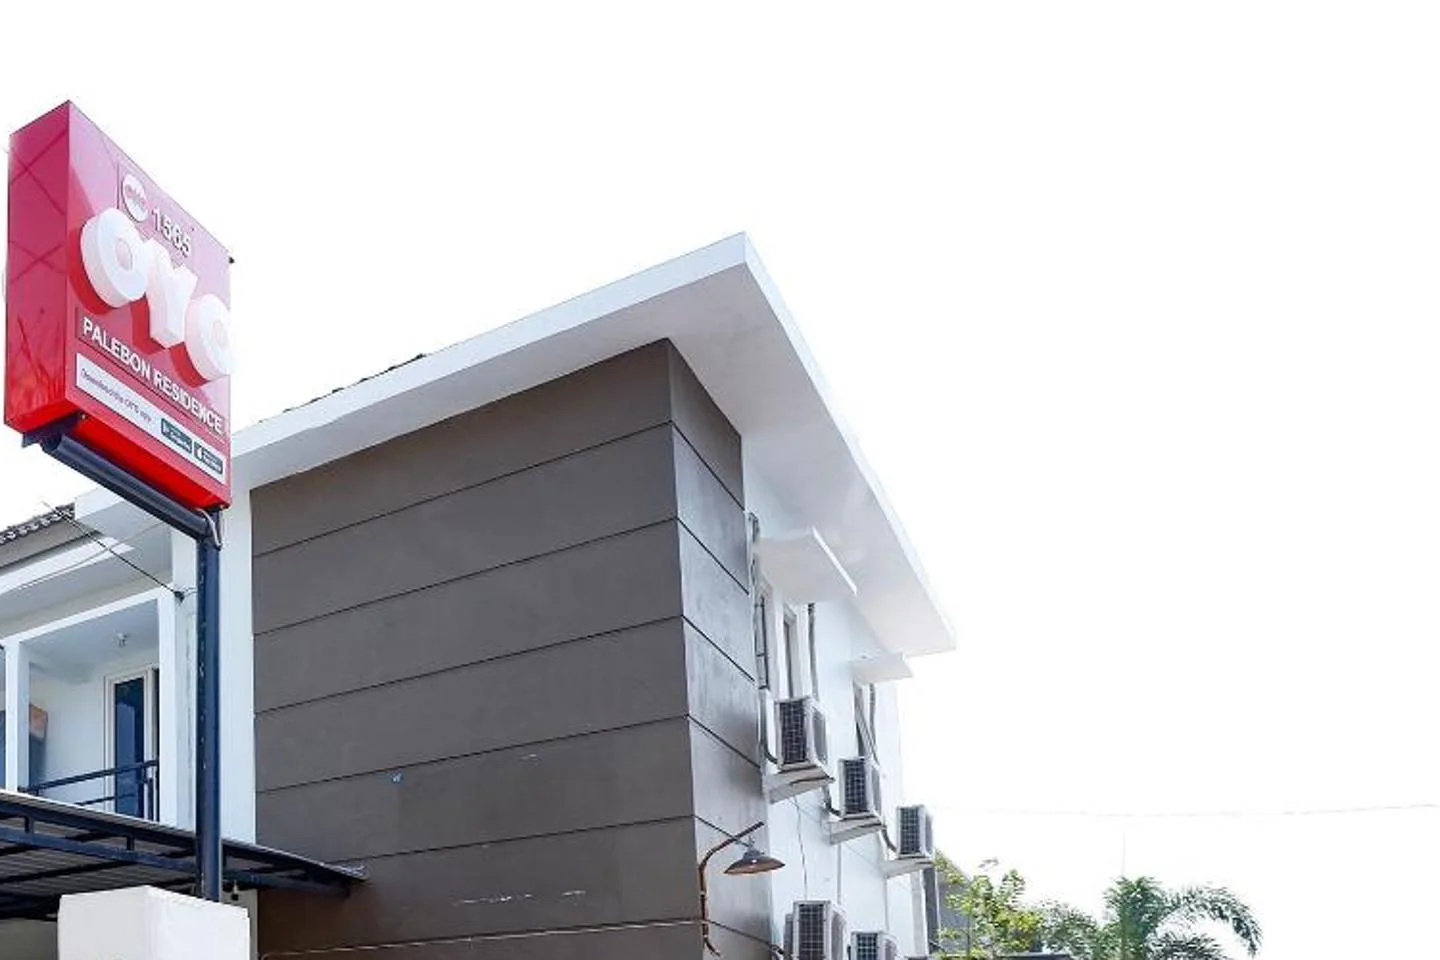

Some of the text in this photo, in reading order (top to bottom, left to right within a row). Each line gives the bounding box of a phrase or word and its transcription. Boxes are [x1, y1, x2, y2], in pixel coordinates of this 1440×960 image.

[80, 207, 233, 382] OYO
[82, 316, 151, 382] PALEBON
[153, 367, 224, 435] RESIDENCE
